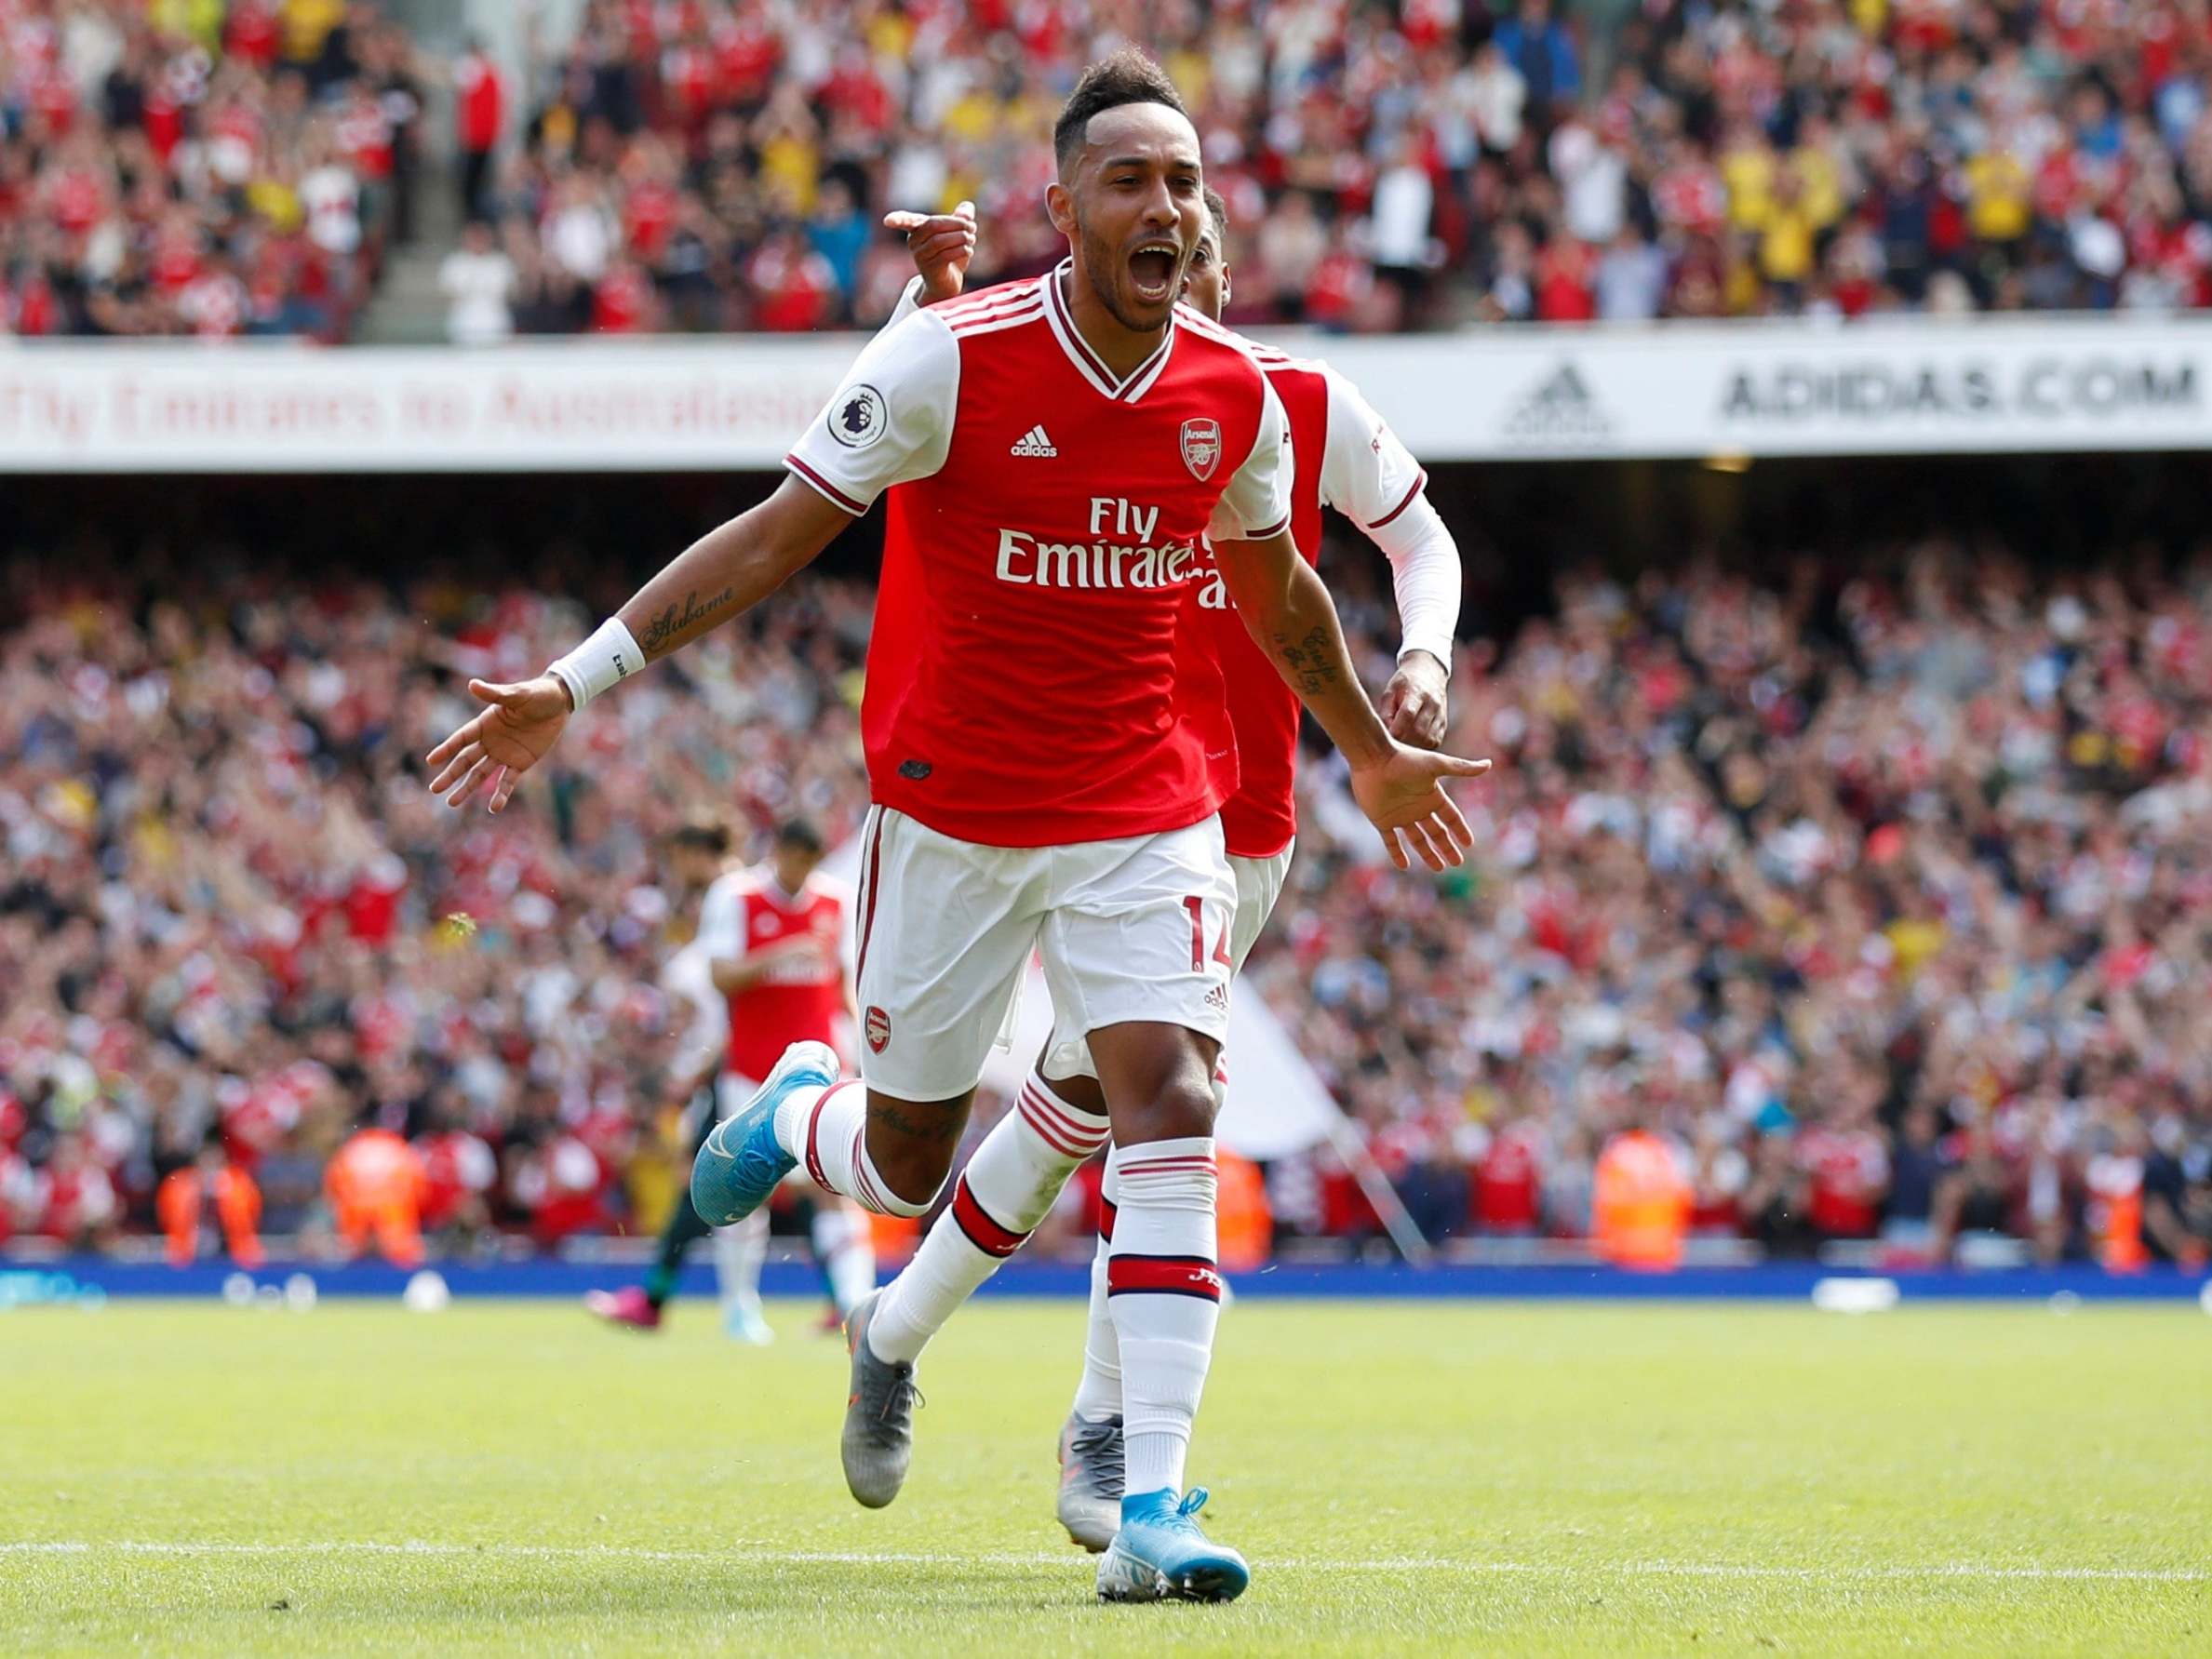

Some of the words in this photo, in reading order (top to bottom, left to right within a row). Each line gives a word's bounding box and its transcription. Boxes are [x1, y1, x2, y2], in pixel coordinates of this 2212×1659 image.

[1724, 362, 2196, 417] ADIDAS.COM
[1011, 444, 1057, 457] adidas
[1090, 498, 1159, 543] Fly
[996, 528, 1193, 588] Emirate
[638, 588, 732, 649] Aubame
